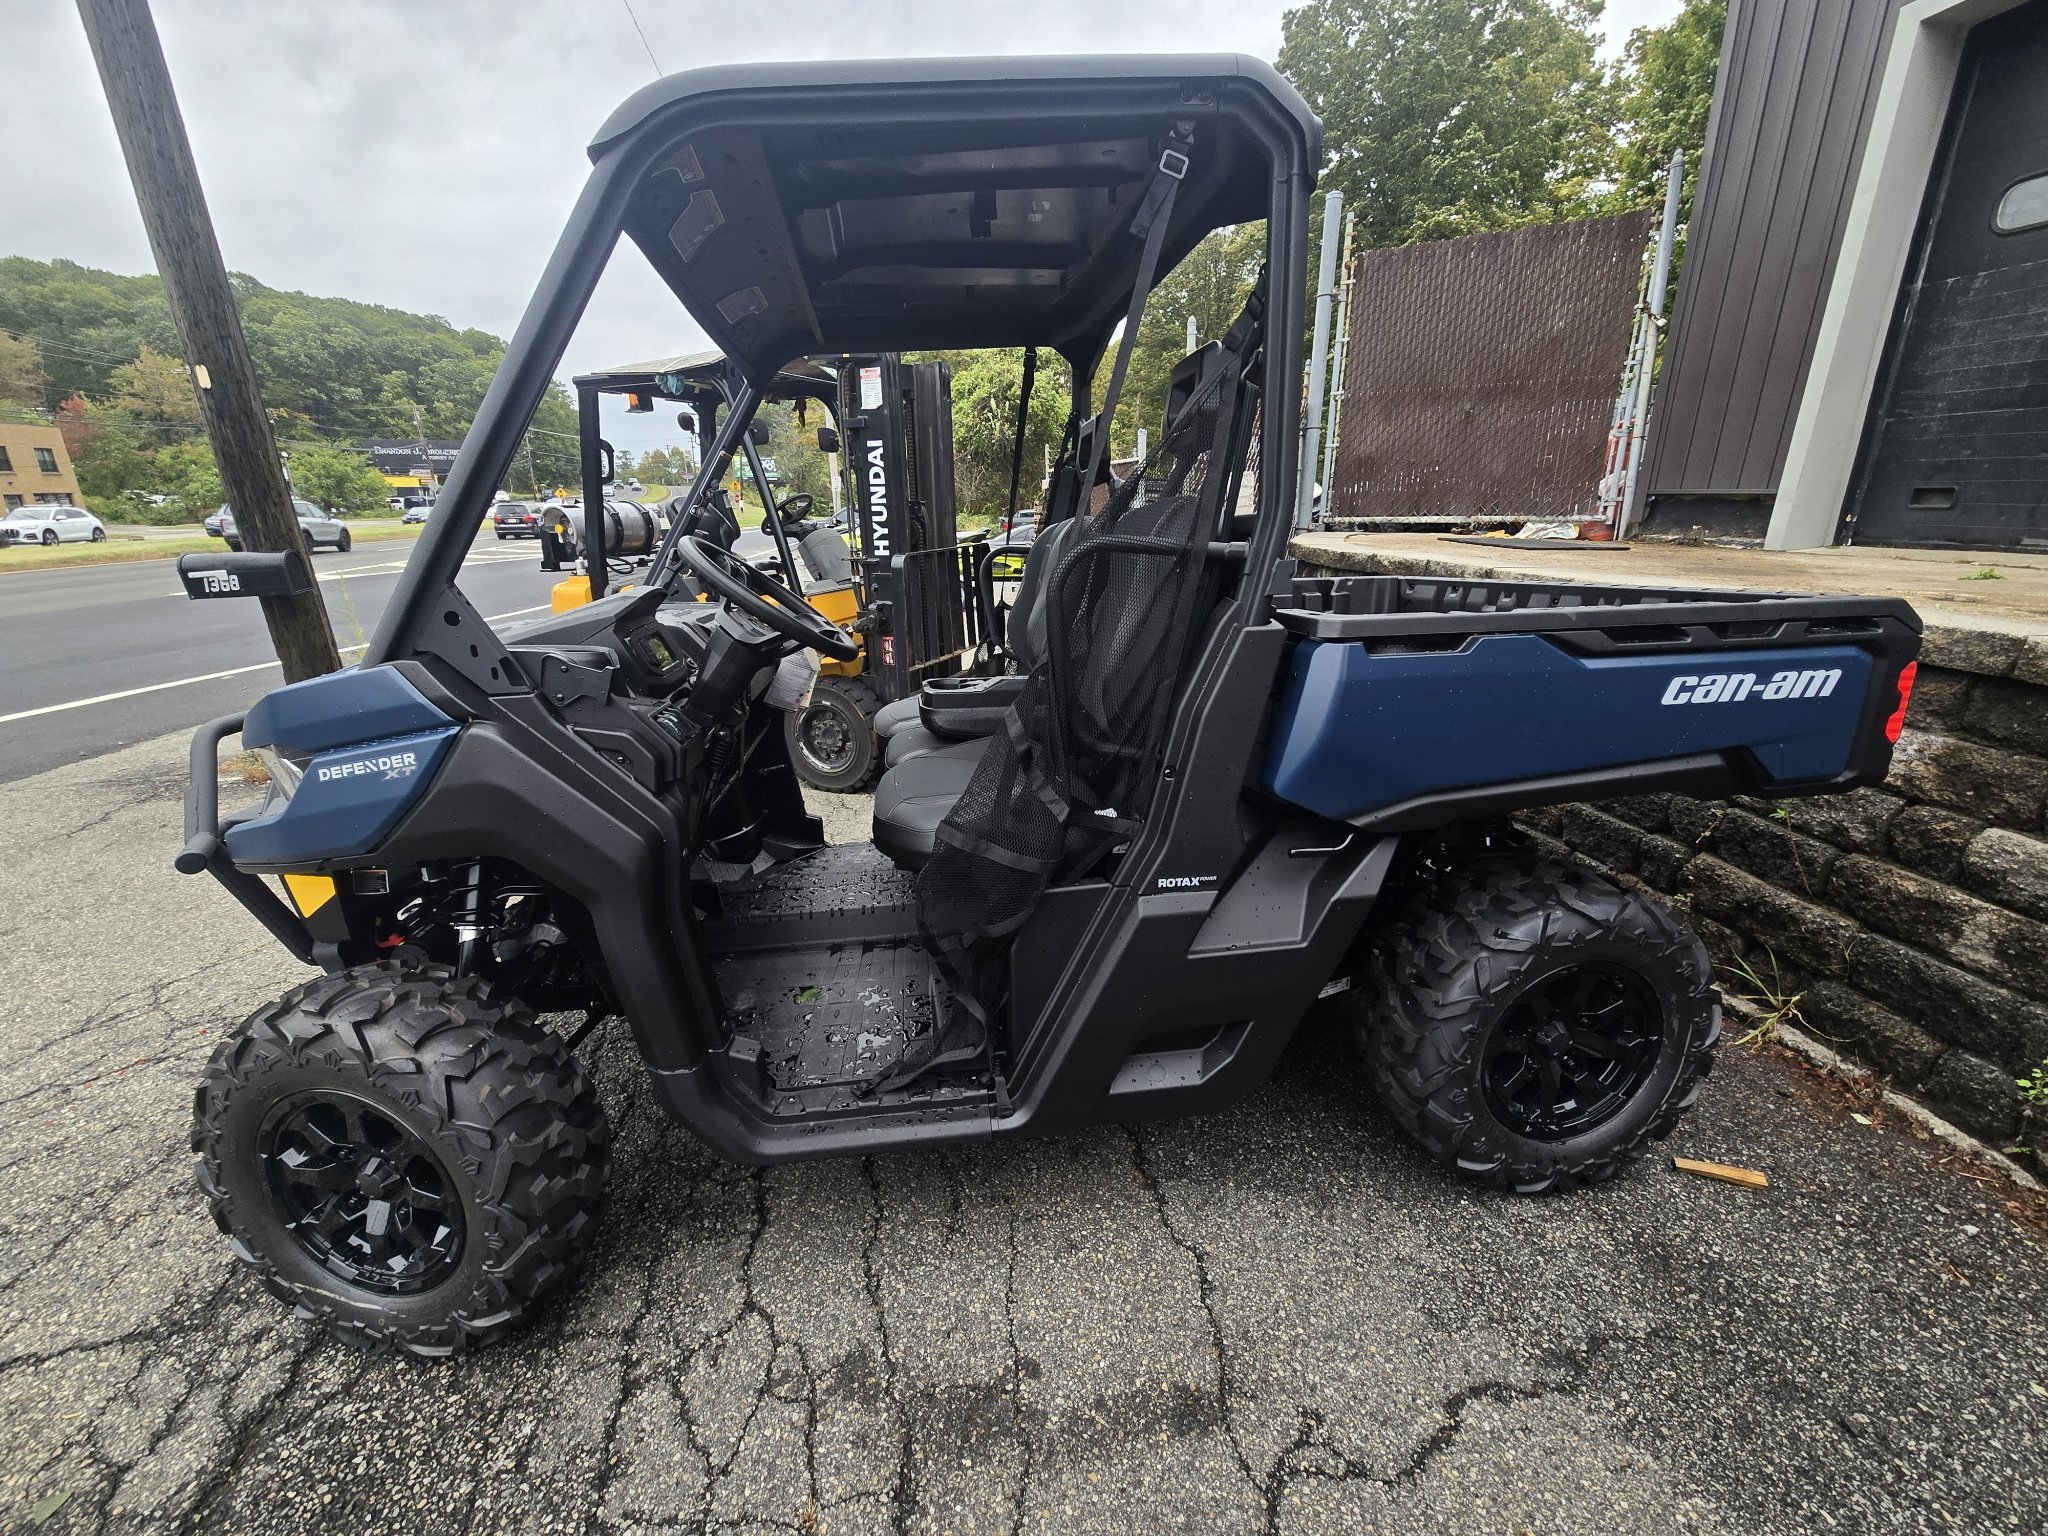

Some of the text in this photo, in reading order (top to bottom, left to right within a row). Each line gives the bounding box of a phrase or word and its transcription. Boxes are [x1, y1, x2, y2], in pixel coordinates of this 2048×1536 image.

[866, 439, 890, 556] HYUNDAI
[1660, 668, 1843, 706] can-am
[318, 752, 417, 782] DEFENDER
[384, 765, 417, 780] XT
[1157, 876, 1200, 888] ROTAX
